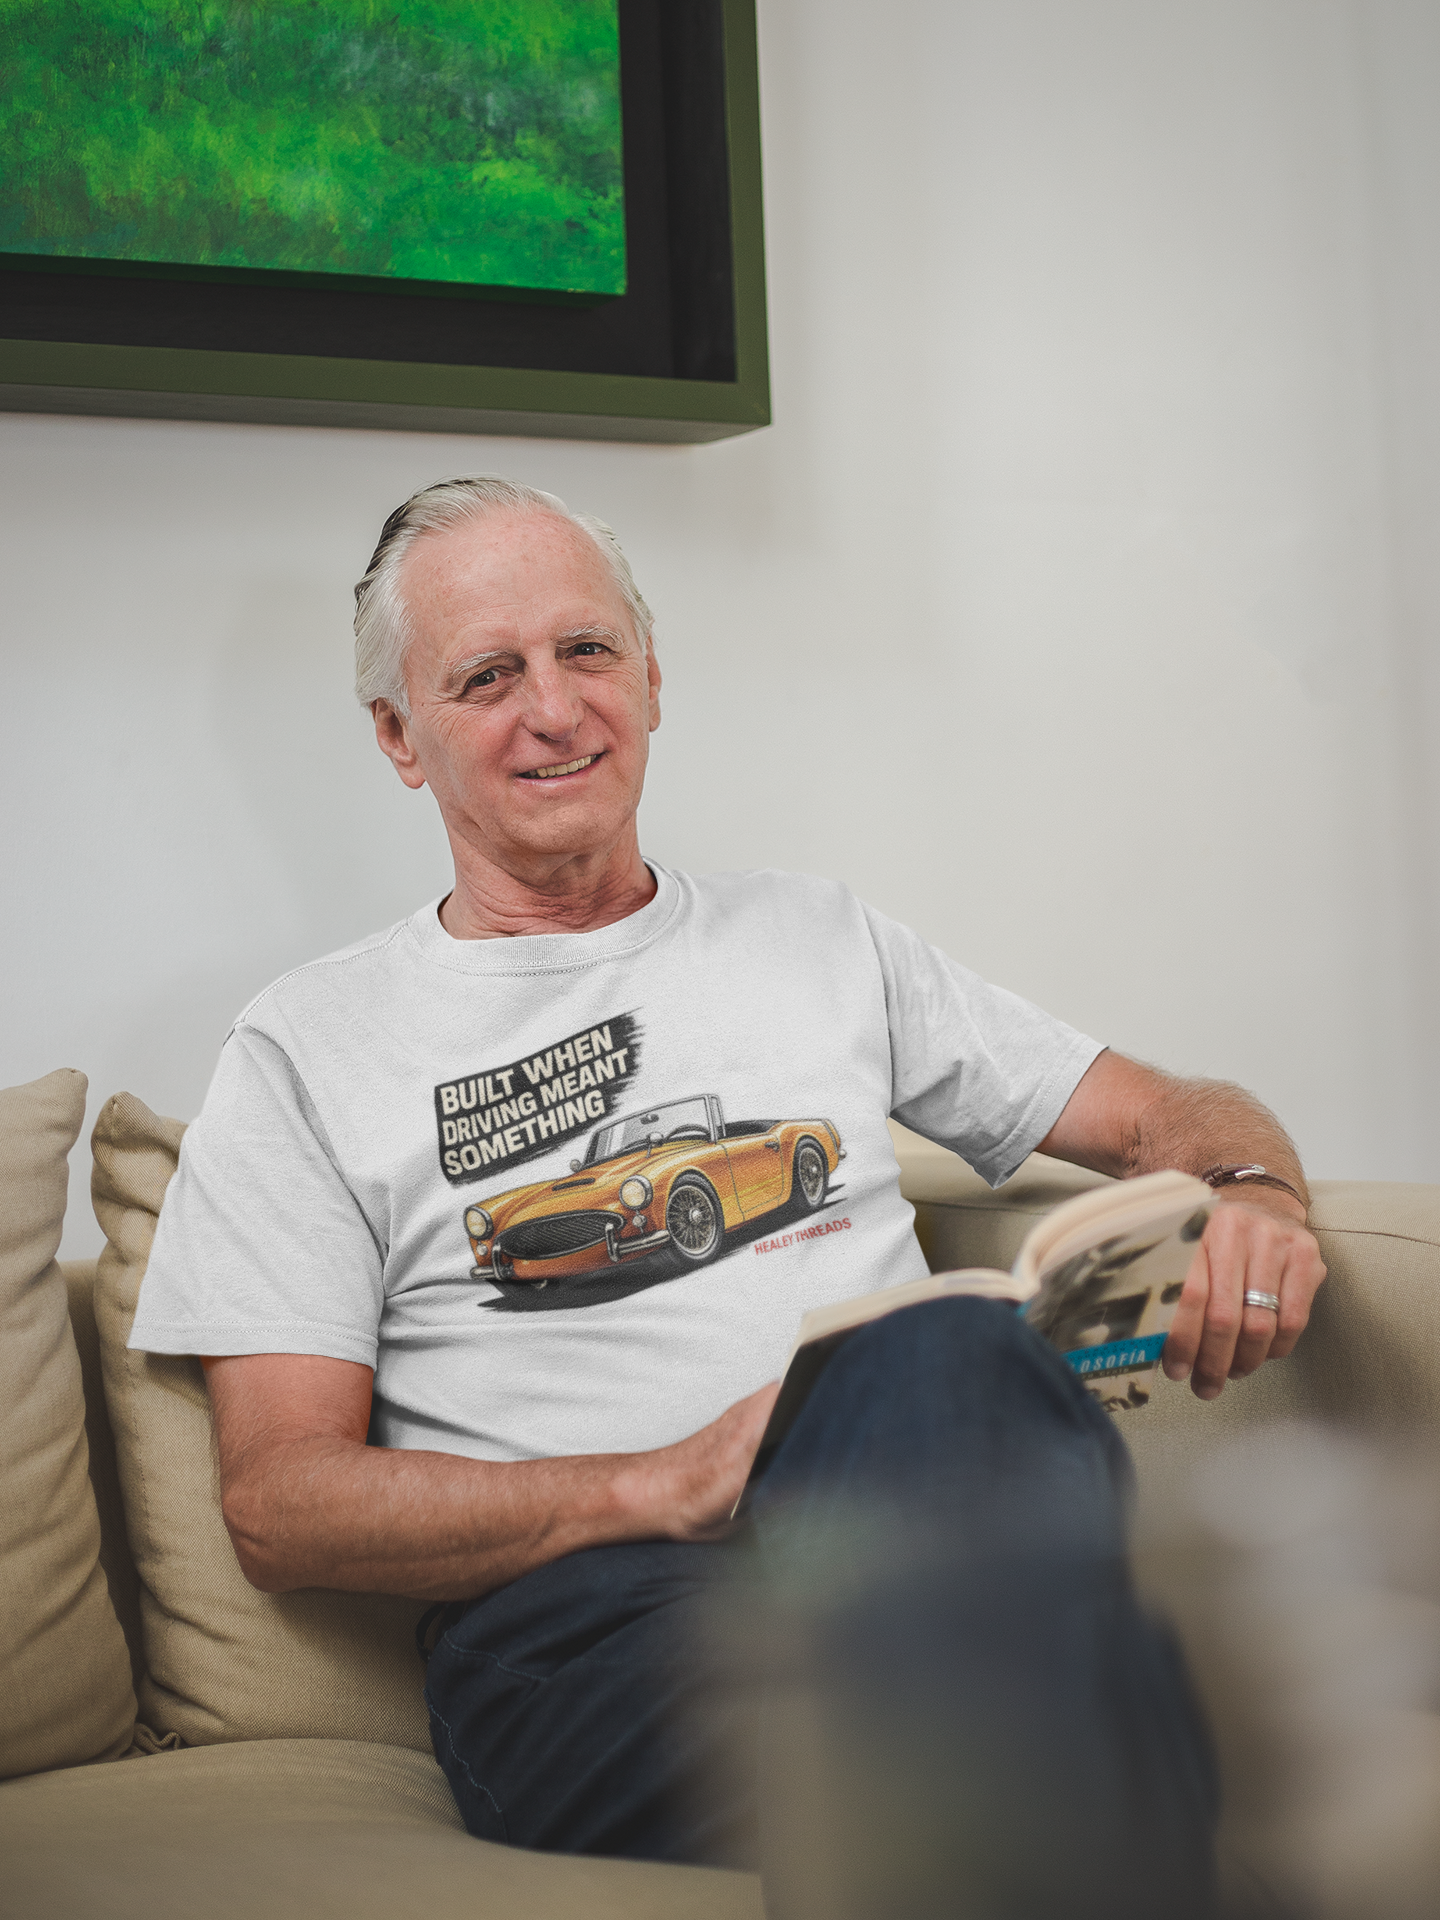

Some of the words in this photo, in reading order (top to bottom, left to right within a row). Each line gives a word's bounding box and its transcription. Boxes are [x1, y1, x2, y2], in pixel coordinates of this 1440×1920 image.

[440, 1068, 514, 1115] BUILT
[521, 1025, 614, 1085] WHEN
[442, 1091, 539, 1146] DRIVING
[539, 1047, 629, 1107] MEANT
[444, 1089, 606, 1176] SOMETHING
[1072, 1346, 1147, 1374] OSOFÍA
